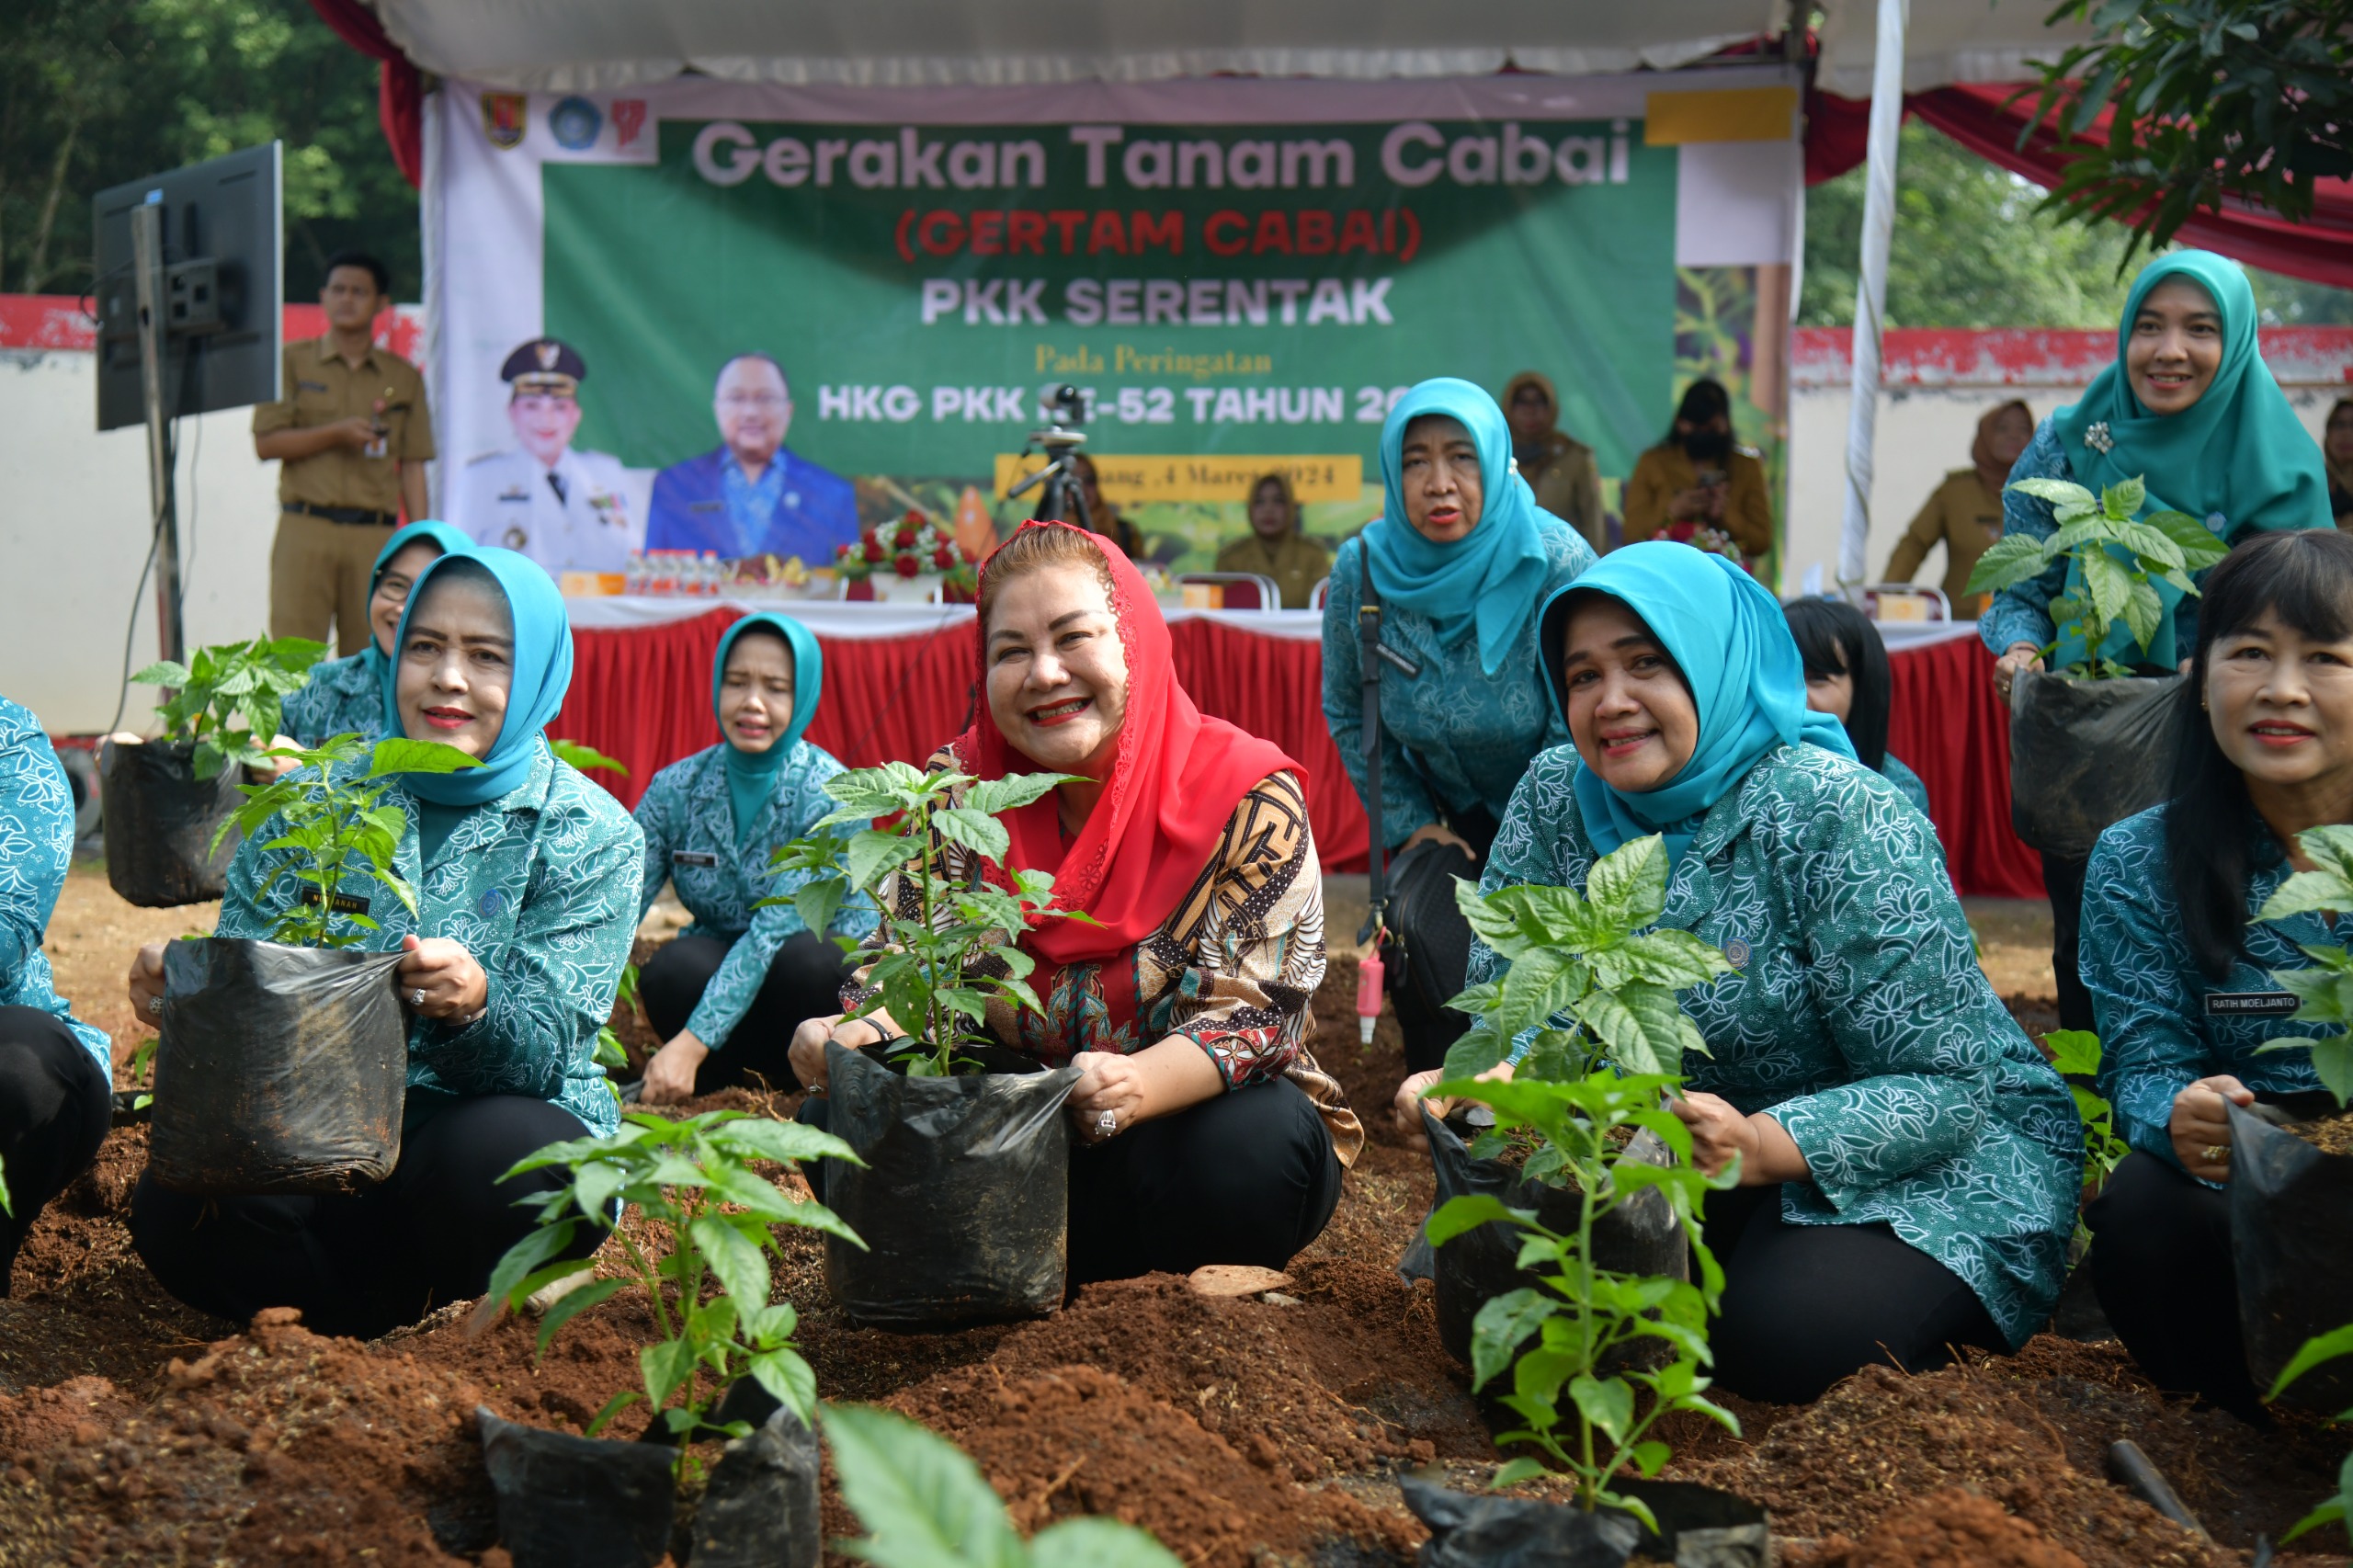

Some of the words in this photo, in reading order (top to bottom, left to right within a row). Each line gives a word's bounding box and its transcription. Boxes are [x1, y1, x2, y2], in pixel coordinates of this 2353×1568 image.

[692, 121, 1046, 188] Gerakan
[1069, 126, 1355, 188] Tanam
[1381, 119, 1631, 186] Cabai
[895, 210, 1184, 263] (GERTAM
[1204, 209, 1421, 263] CABAI)
[921, 278, 1050, 326] PKK
[1063, 278, 1395, 326] SERENTAK
[1035, 343, 1105, 375] Pada
[1114, 343, 1273, 382] Peringatan
[818, 384, 922, 423] HKG
[931, 385, 1027, 423] PKK
[1184, 386, 1345, 424] TAHUN
[2212, 999, 2238, 1008] RATIH
[2241, 998, 2295, 1007] MOELJANTO
